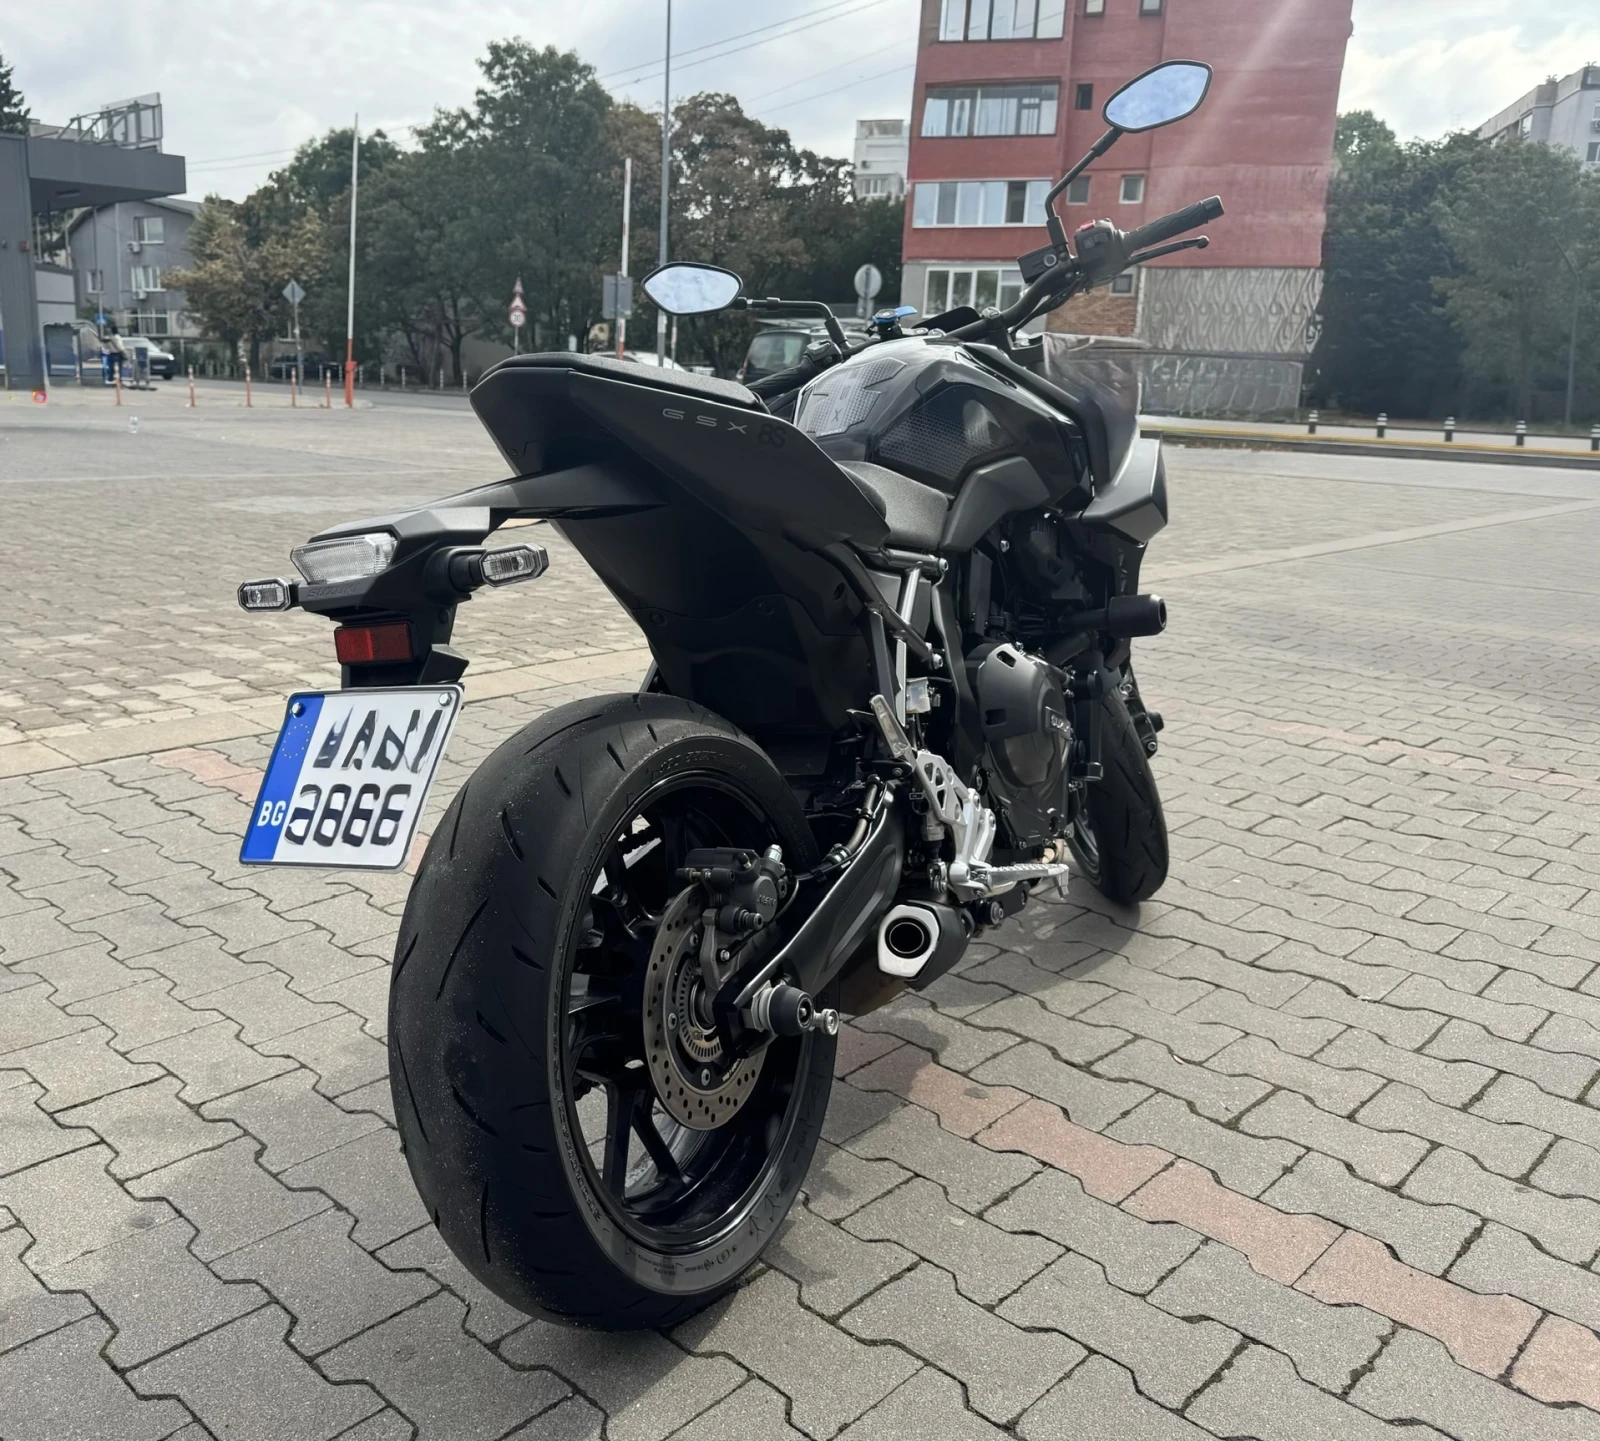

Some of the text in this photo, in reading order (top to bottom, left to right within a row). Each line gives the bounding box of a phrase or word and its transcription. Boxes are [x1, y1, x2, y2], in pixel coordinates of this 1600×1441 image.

[662, 408, 786, 448] GSX 8S
[308, 582, 358, 599] SUZUKI
[257, 800, 287, 827] BG
